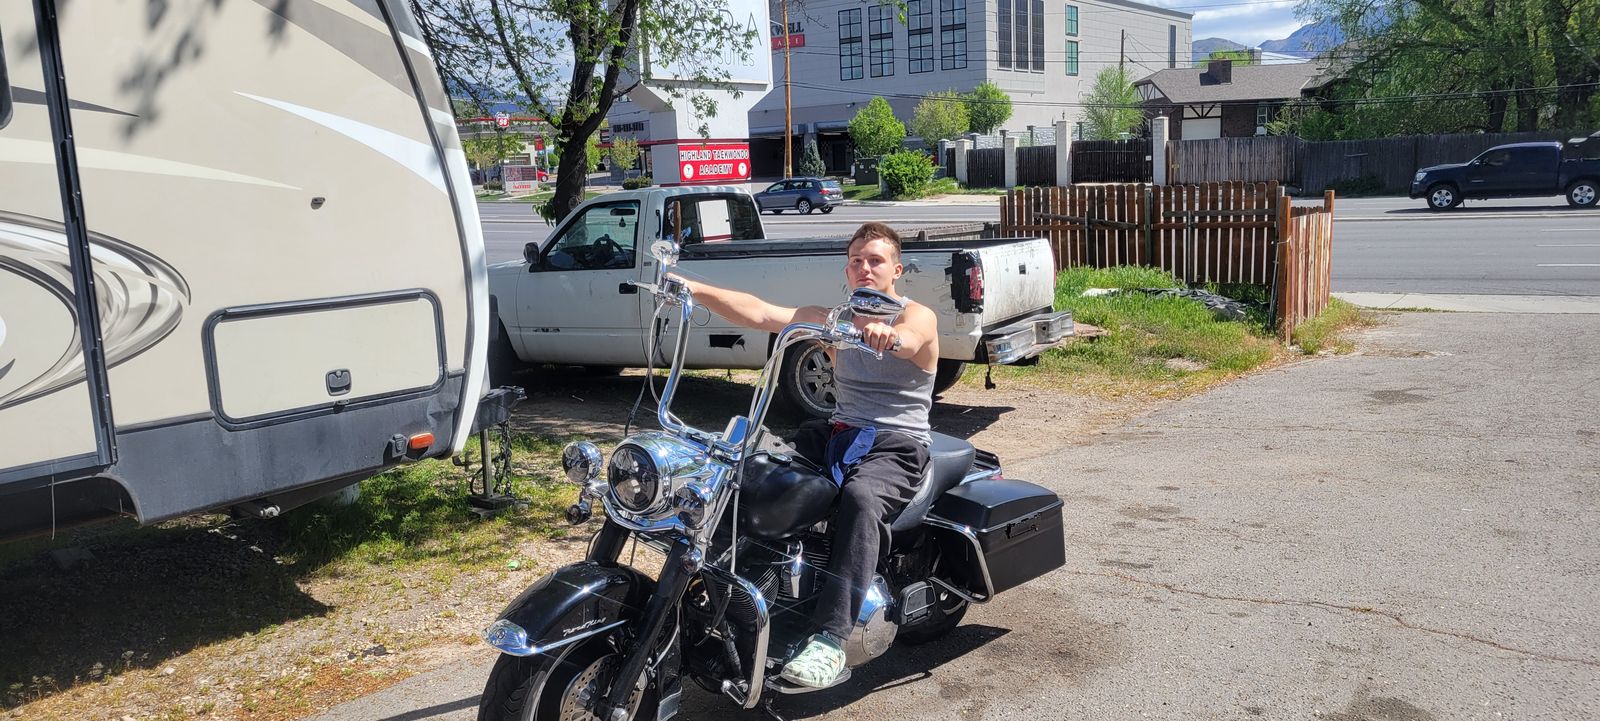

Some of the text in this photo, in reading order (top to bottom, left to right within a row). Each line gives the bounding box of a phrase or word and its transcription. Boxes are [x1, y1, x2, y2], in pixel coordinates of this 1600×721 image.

[680, 149, 749, 161] HIGHLAND TAEKWONDO
[699, 163, 733, 175] ACADEMY
